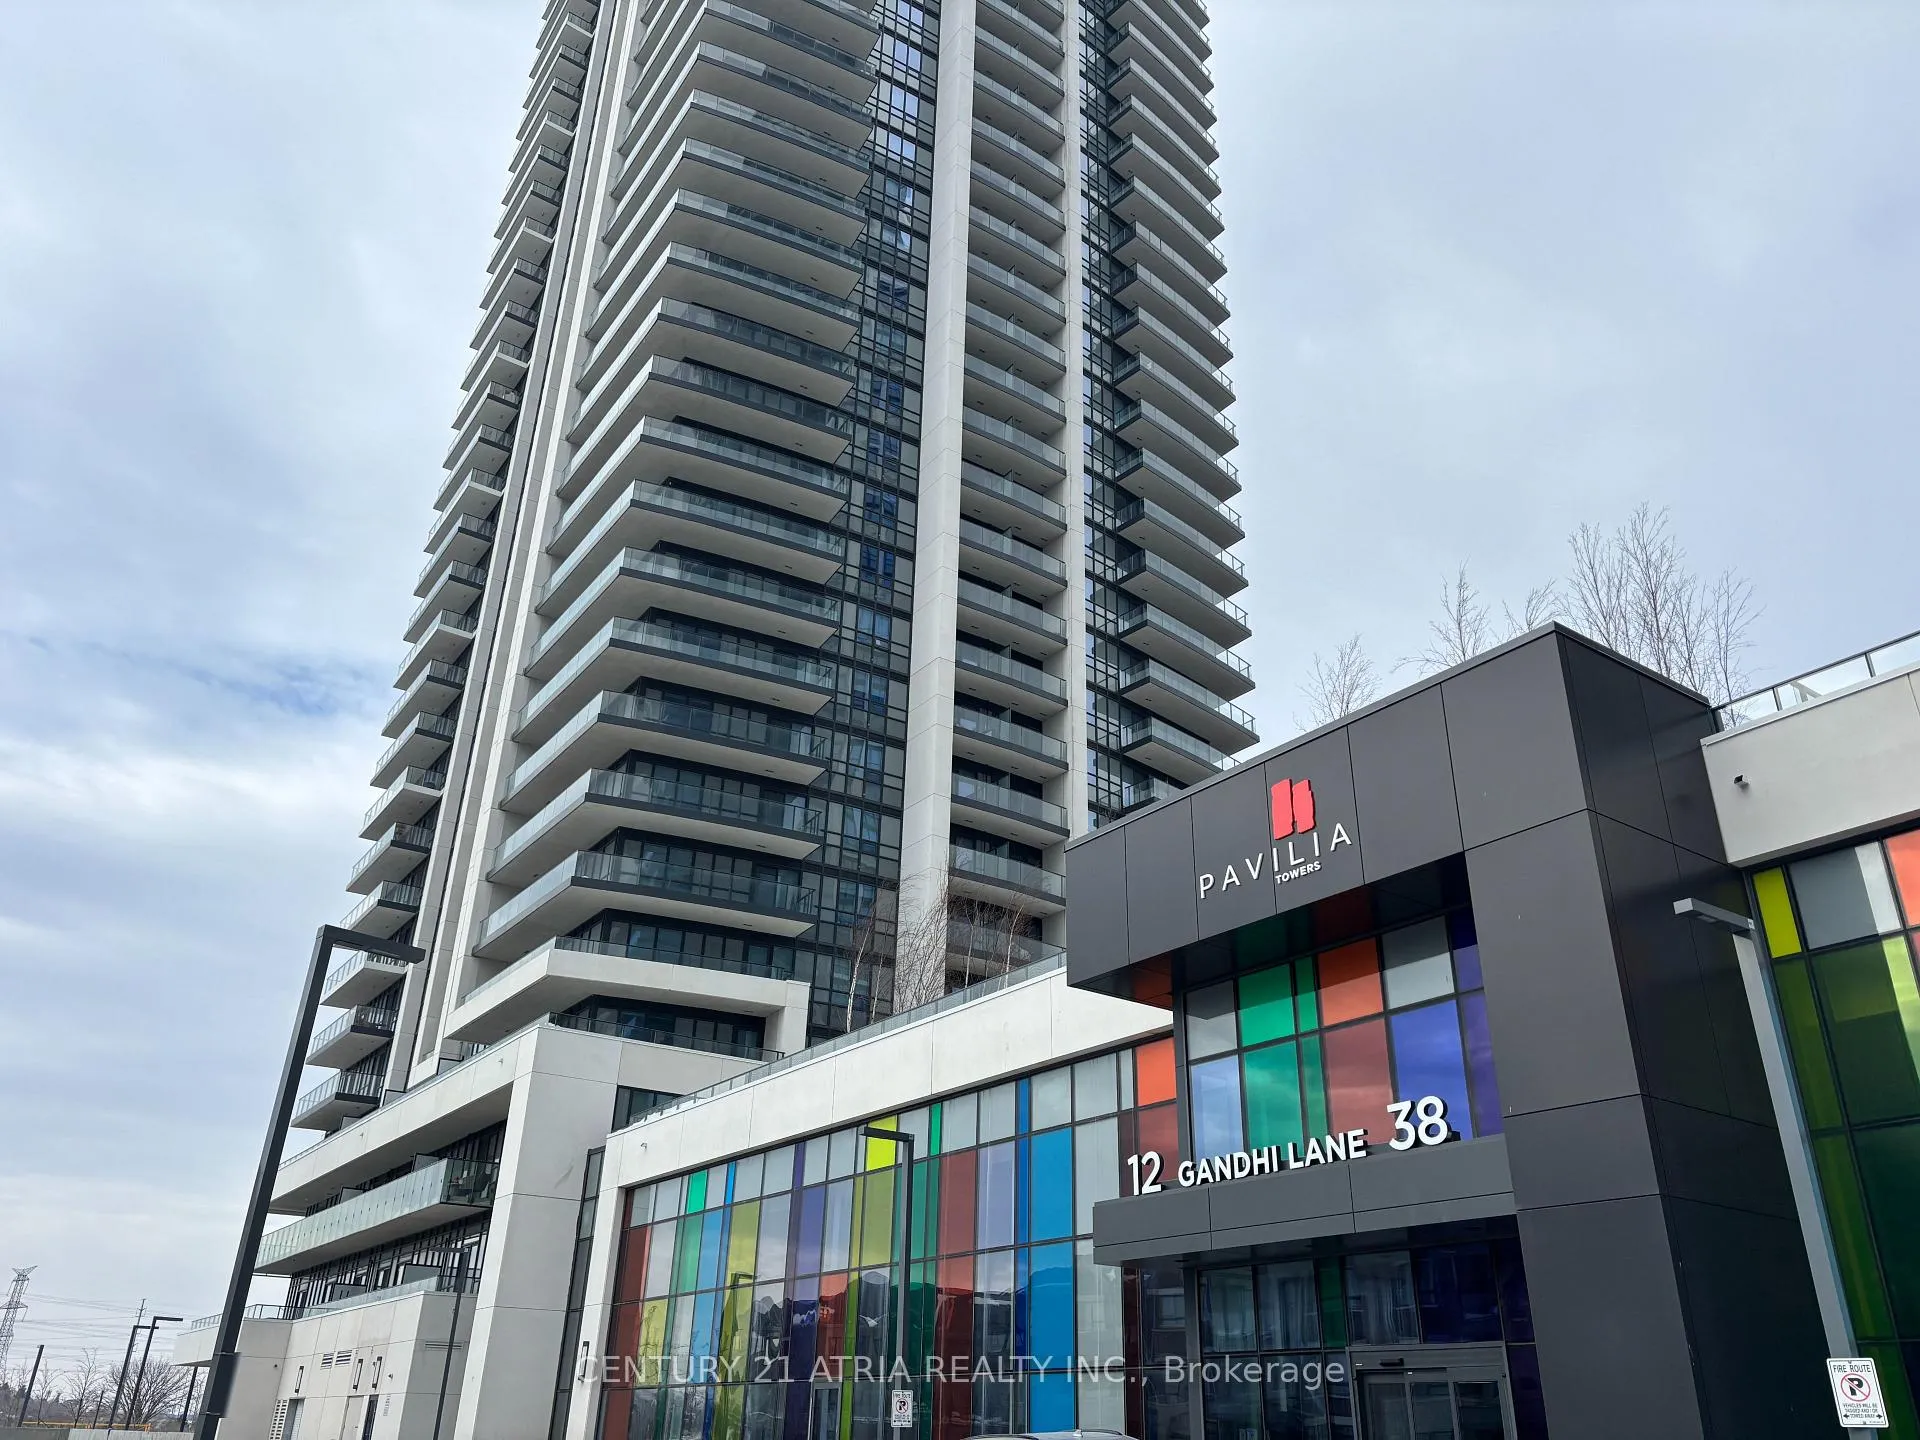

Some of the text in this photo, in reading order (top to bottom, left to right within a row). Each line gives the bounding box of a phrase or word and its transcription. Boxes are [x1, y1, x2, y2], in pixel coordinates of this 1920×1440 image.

[1200, 822, 1353, 899] PAVILIA
[1275, 861, 1322, 884] TOWERS
[1127, 1095, 1449, 1196] 12 GANDHI LANE 38
[1832, 1364, 1871, 1373] FIRE ROUTE
